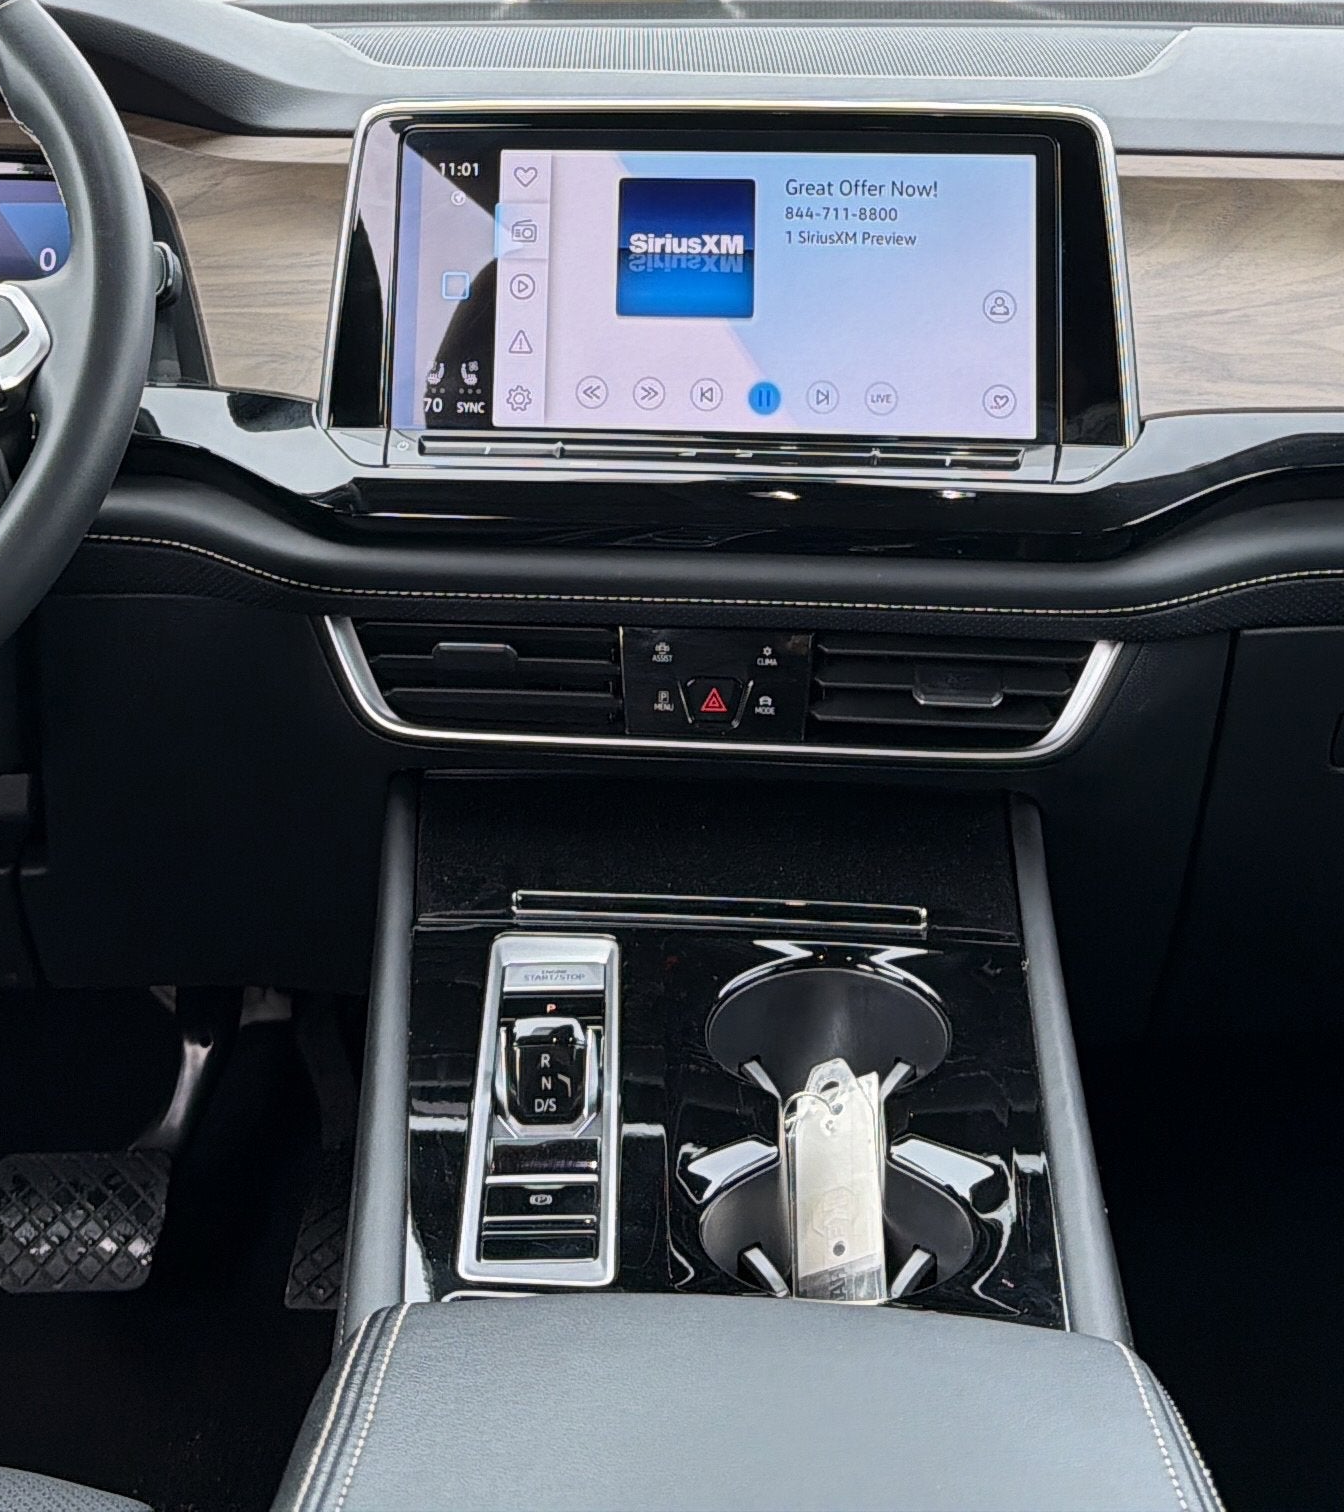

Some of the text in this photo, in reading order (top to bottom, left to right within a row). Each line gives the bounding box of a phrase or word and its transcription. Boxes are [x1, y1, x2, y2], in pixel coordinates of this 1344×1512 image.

[439, 161, 479, 177] 11:01
[785, 178, 938, 199] Great Offer Now!
[784, 206, 898, 222] 844-711-8800
[628, 232, 745, 256] SiriusXM
[785, 230, 917, 246] 1 SiriusXM Preview
[38, 247, 56, 272] 0
[423, 397, 487, 414] 70 SYNC
[870, 393, 893, 405] LIVE
[652, 654, 673, 663] ASSIST
[756, 657, 778, 666] CLIMA
[653, 703, 675, 711] MENU
[755, 706, 776, 715] MODE
[523, 973, 586, 981] START/STOP
[546, 1003, 557, 1014] P
[540, 1053, 551, 1069] R
[541, 1075, 552, 1091] N
[534, 1097, 557, 1113] D/S
